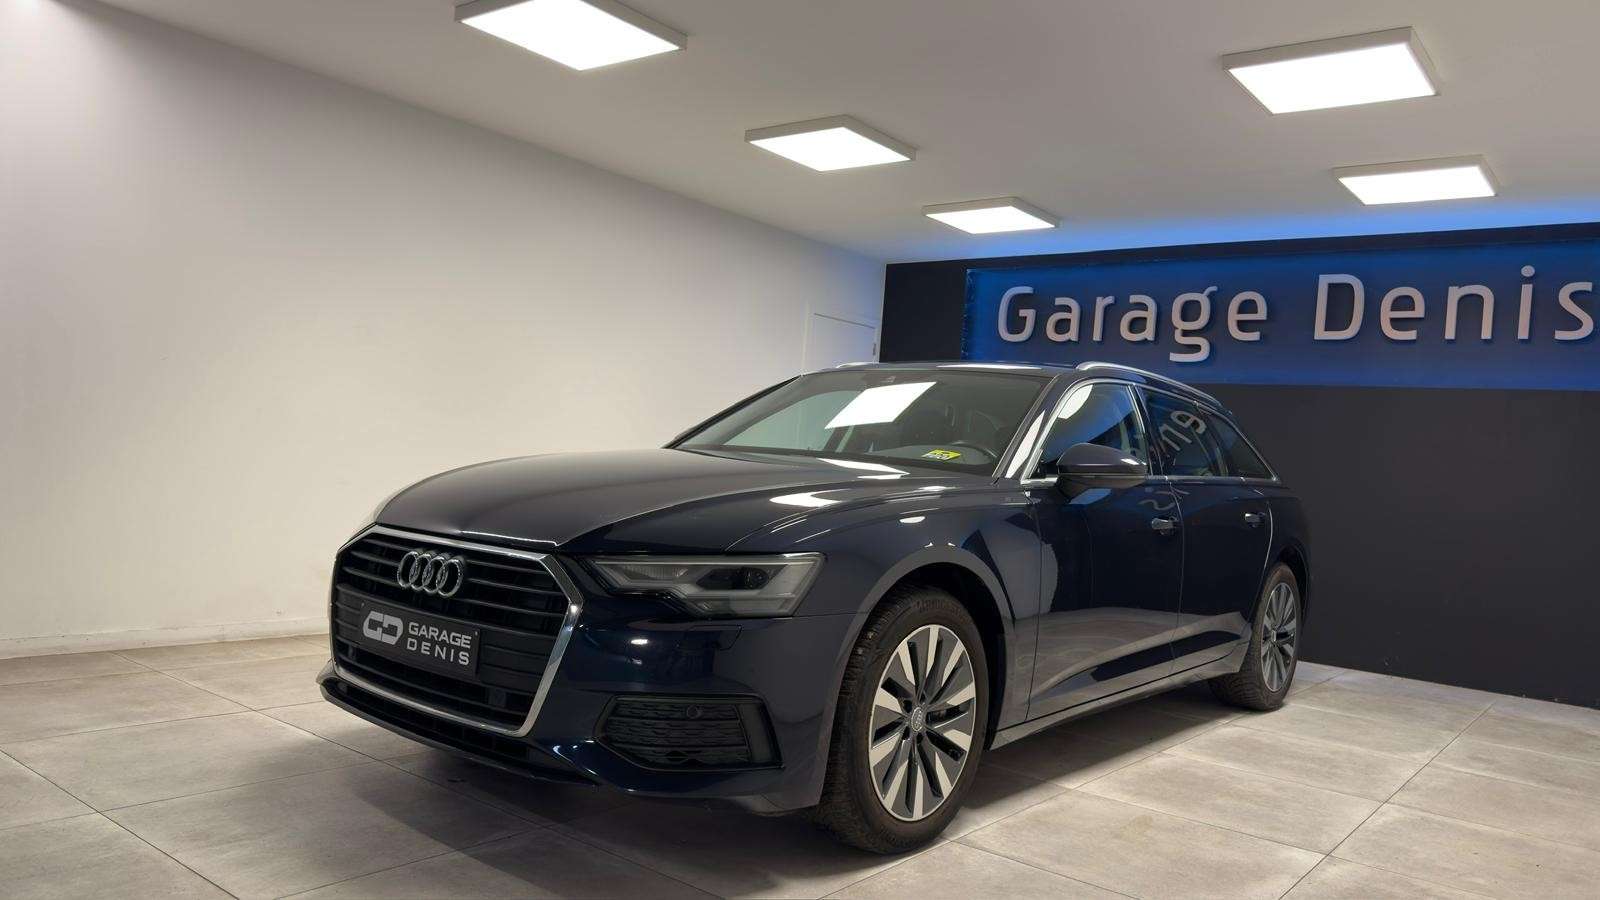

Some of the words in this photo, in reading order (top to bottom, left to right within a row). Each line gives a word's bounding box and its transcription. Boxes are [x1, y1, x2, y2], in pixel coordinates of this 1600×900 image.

[998, 285, 1268, 363] Garage
[1313, 265, 1594, 341] Denis
[408, 621, 473, 649] GARAGE
[406, 637, 470, 666] DENIS
